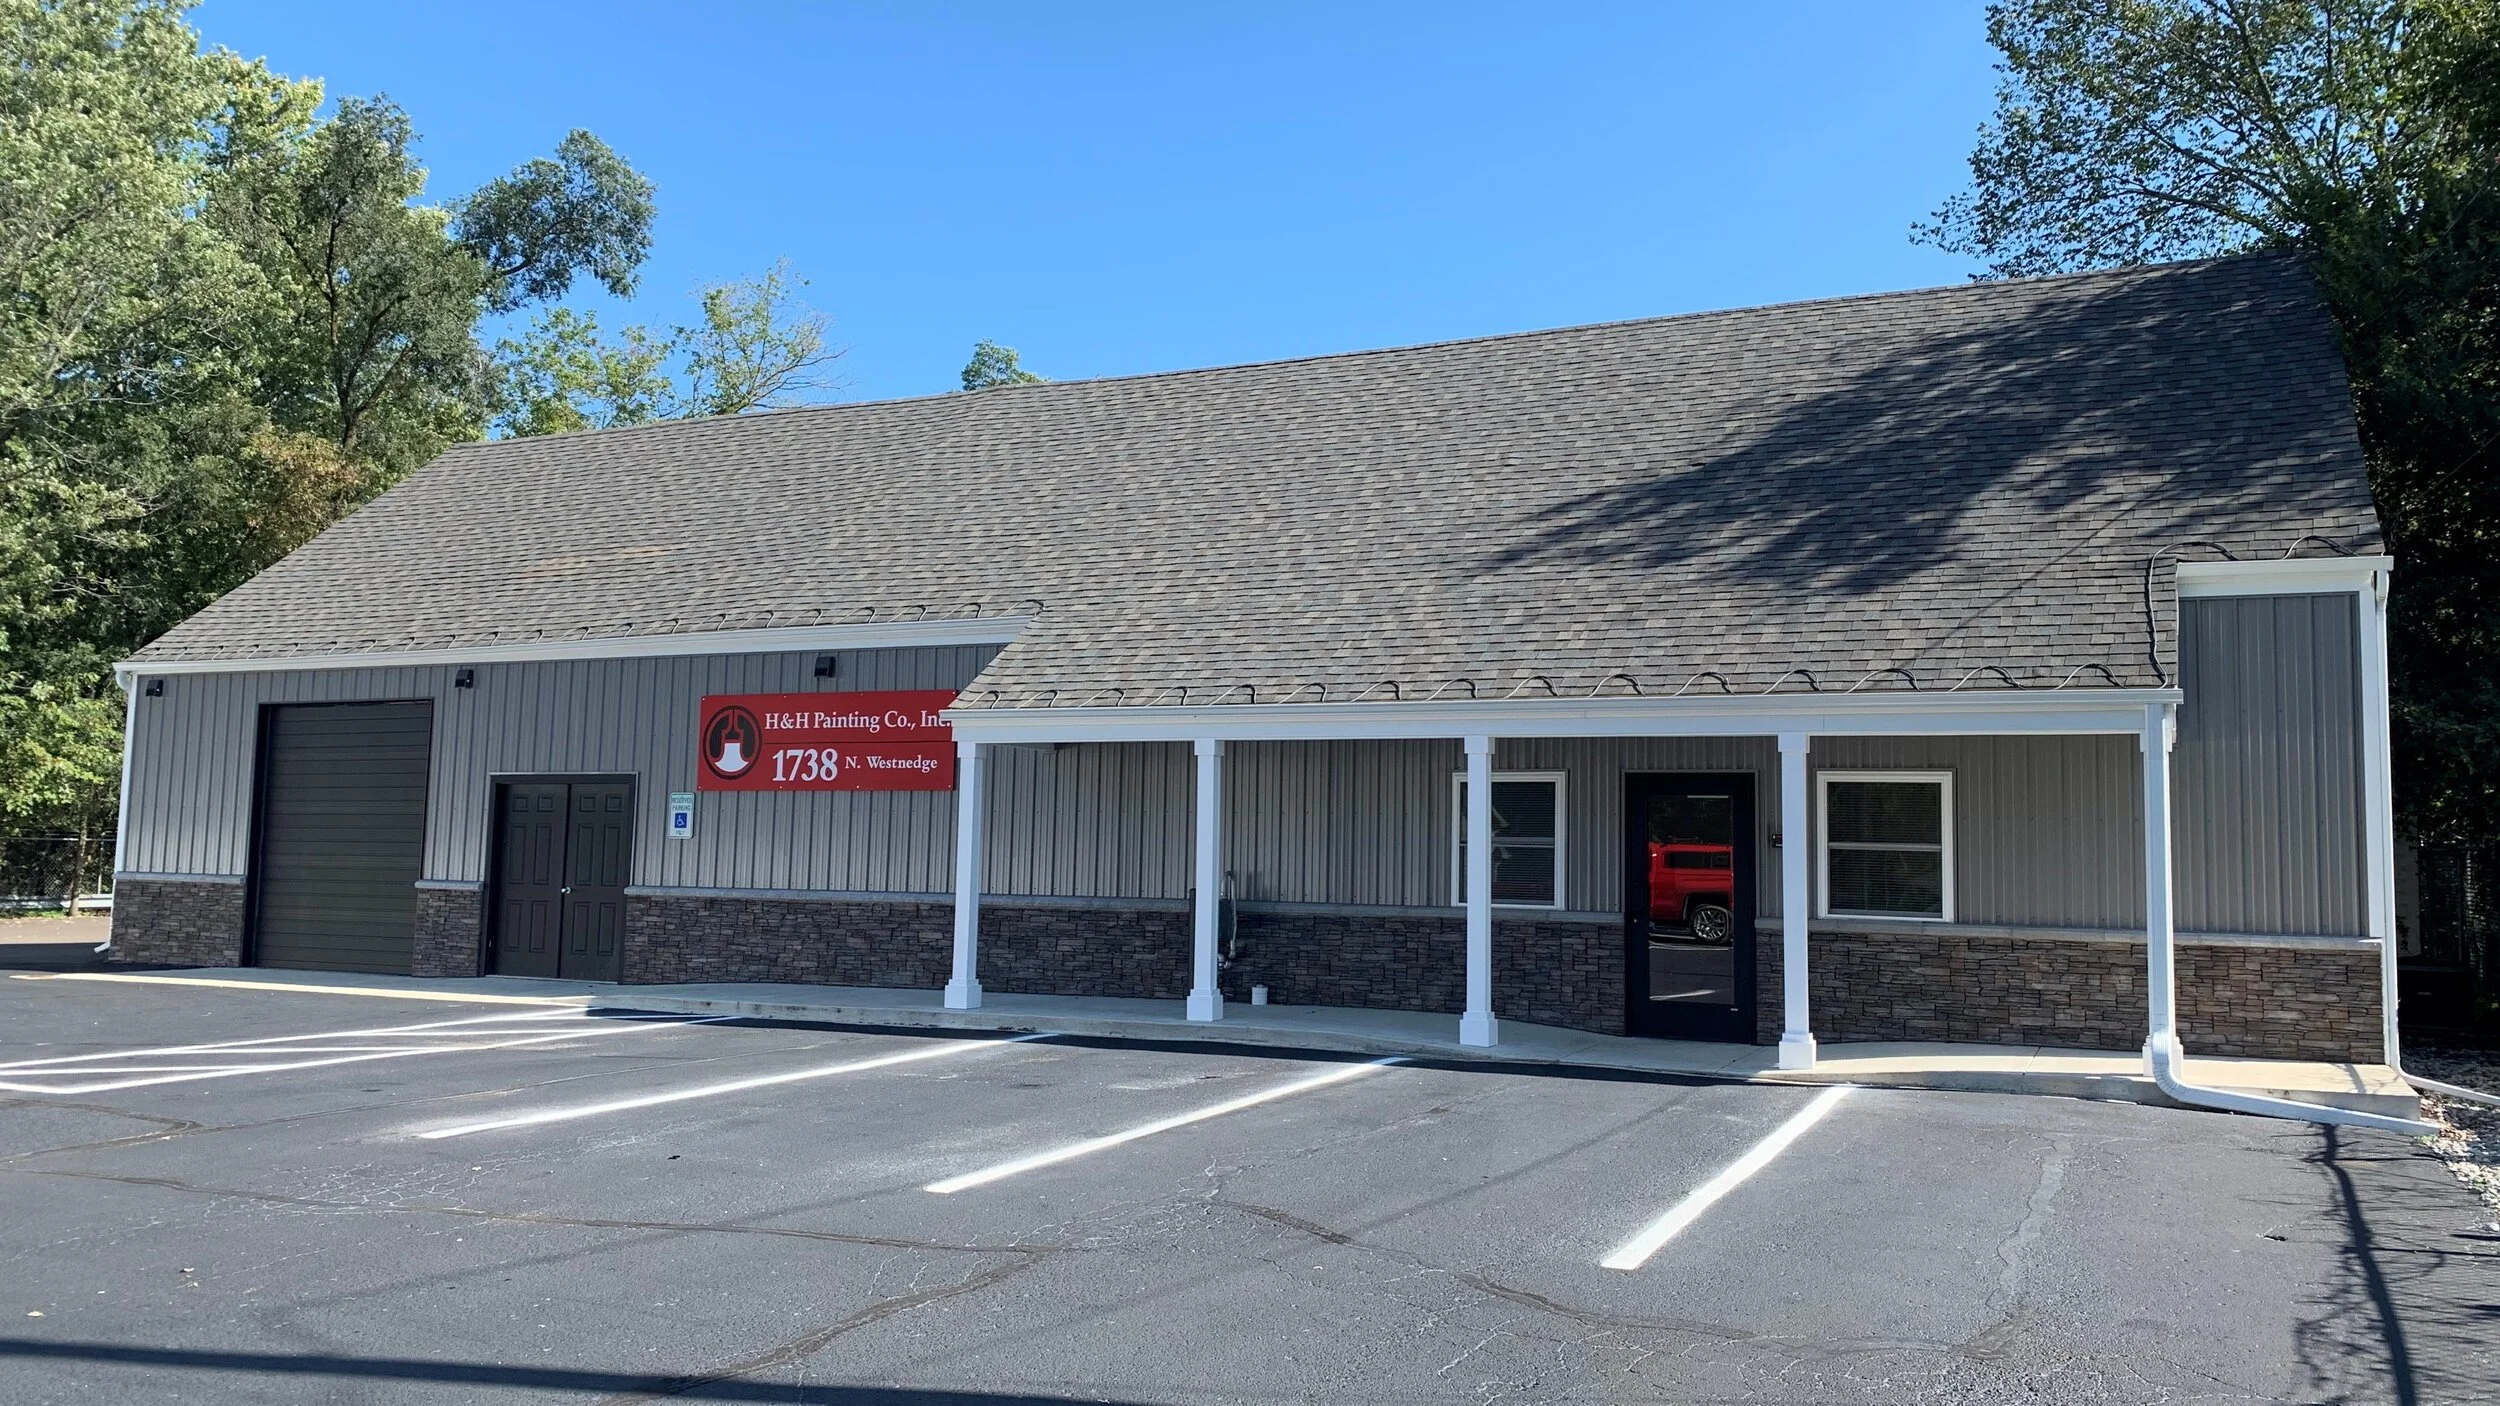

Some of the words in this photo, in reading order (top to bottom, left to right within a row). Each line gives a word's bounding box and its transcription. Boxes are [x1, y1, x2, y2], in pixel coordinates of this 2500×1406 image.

[765, 712, 810, 730] H&H
[813, 711, 881, 733] Painting
[884, 710, 916, 731] Co.,
[772, 748, 839, 782] 1738
[844, 756, 861, 769] N.
[866, 754, 938, 773] Westnedge
